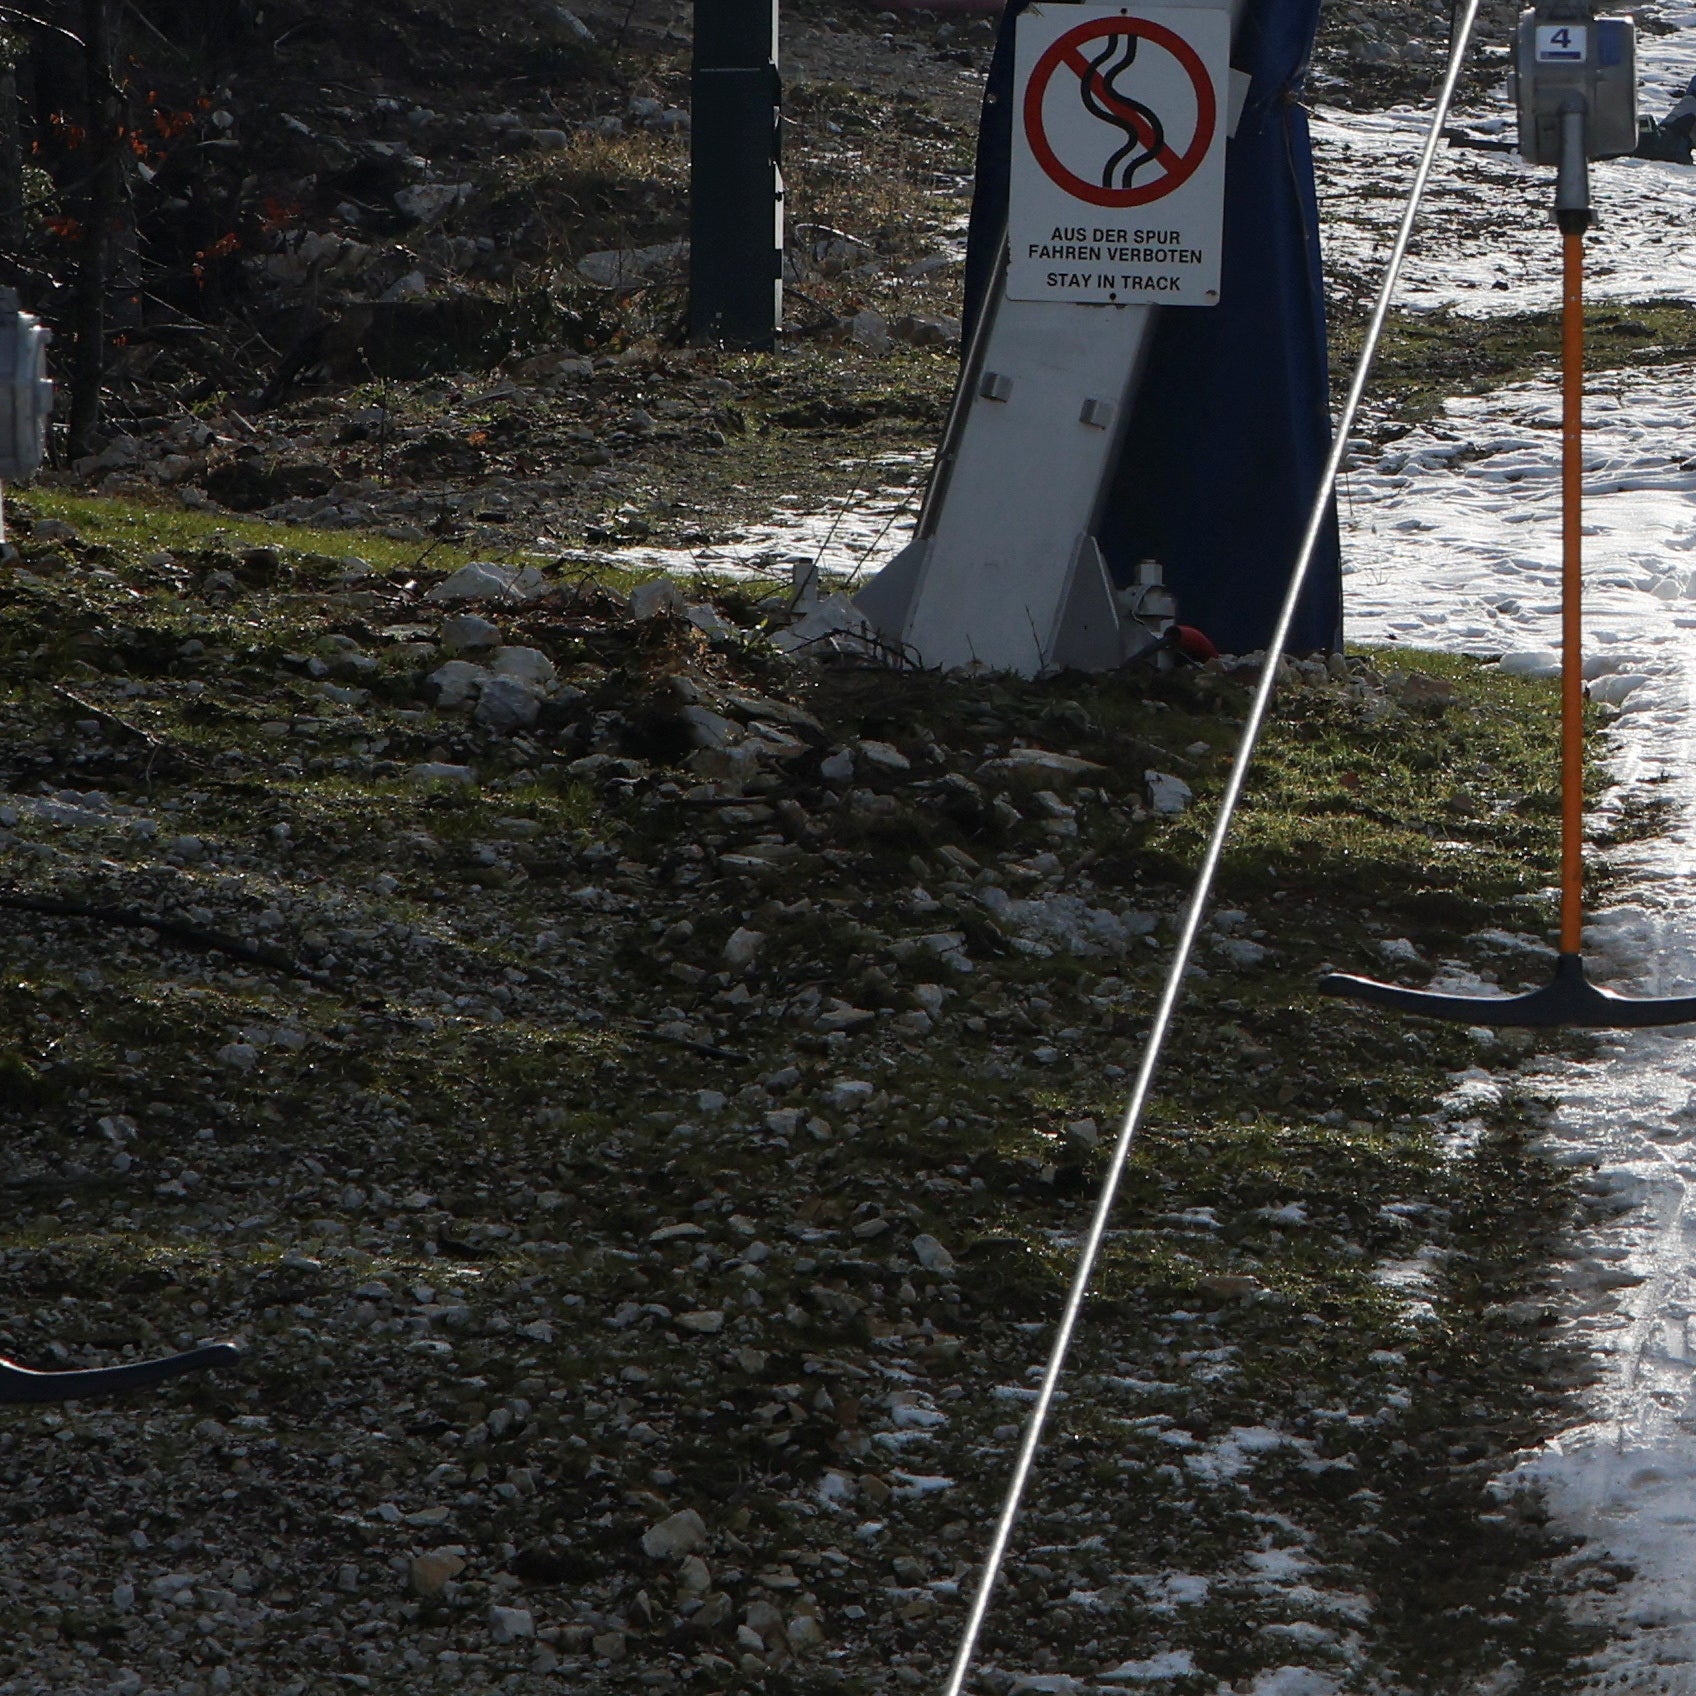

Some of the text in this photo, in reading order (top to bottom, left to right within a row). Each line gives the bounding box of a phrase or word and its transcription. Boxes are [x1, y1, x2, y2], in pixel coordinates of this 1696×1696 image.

[1550, 28, 1571, 49] 4
[1050, 227, 1181, 245] AUS DER SPUR
[1028, 244, 1202, 264] FAHREN VERBOTEN
[1046, 272, 1181, 291] STAY IN TRACK
